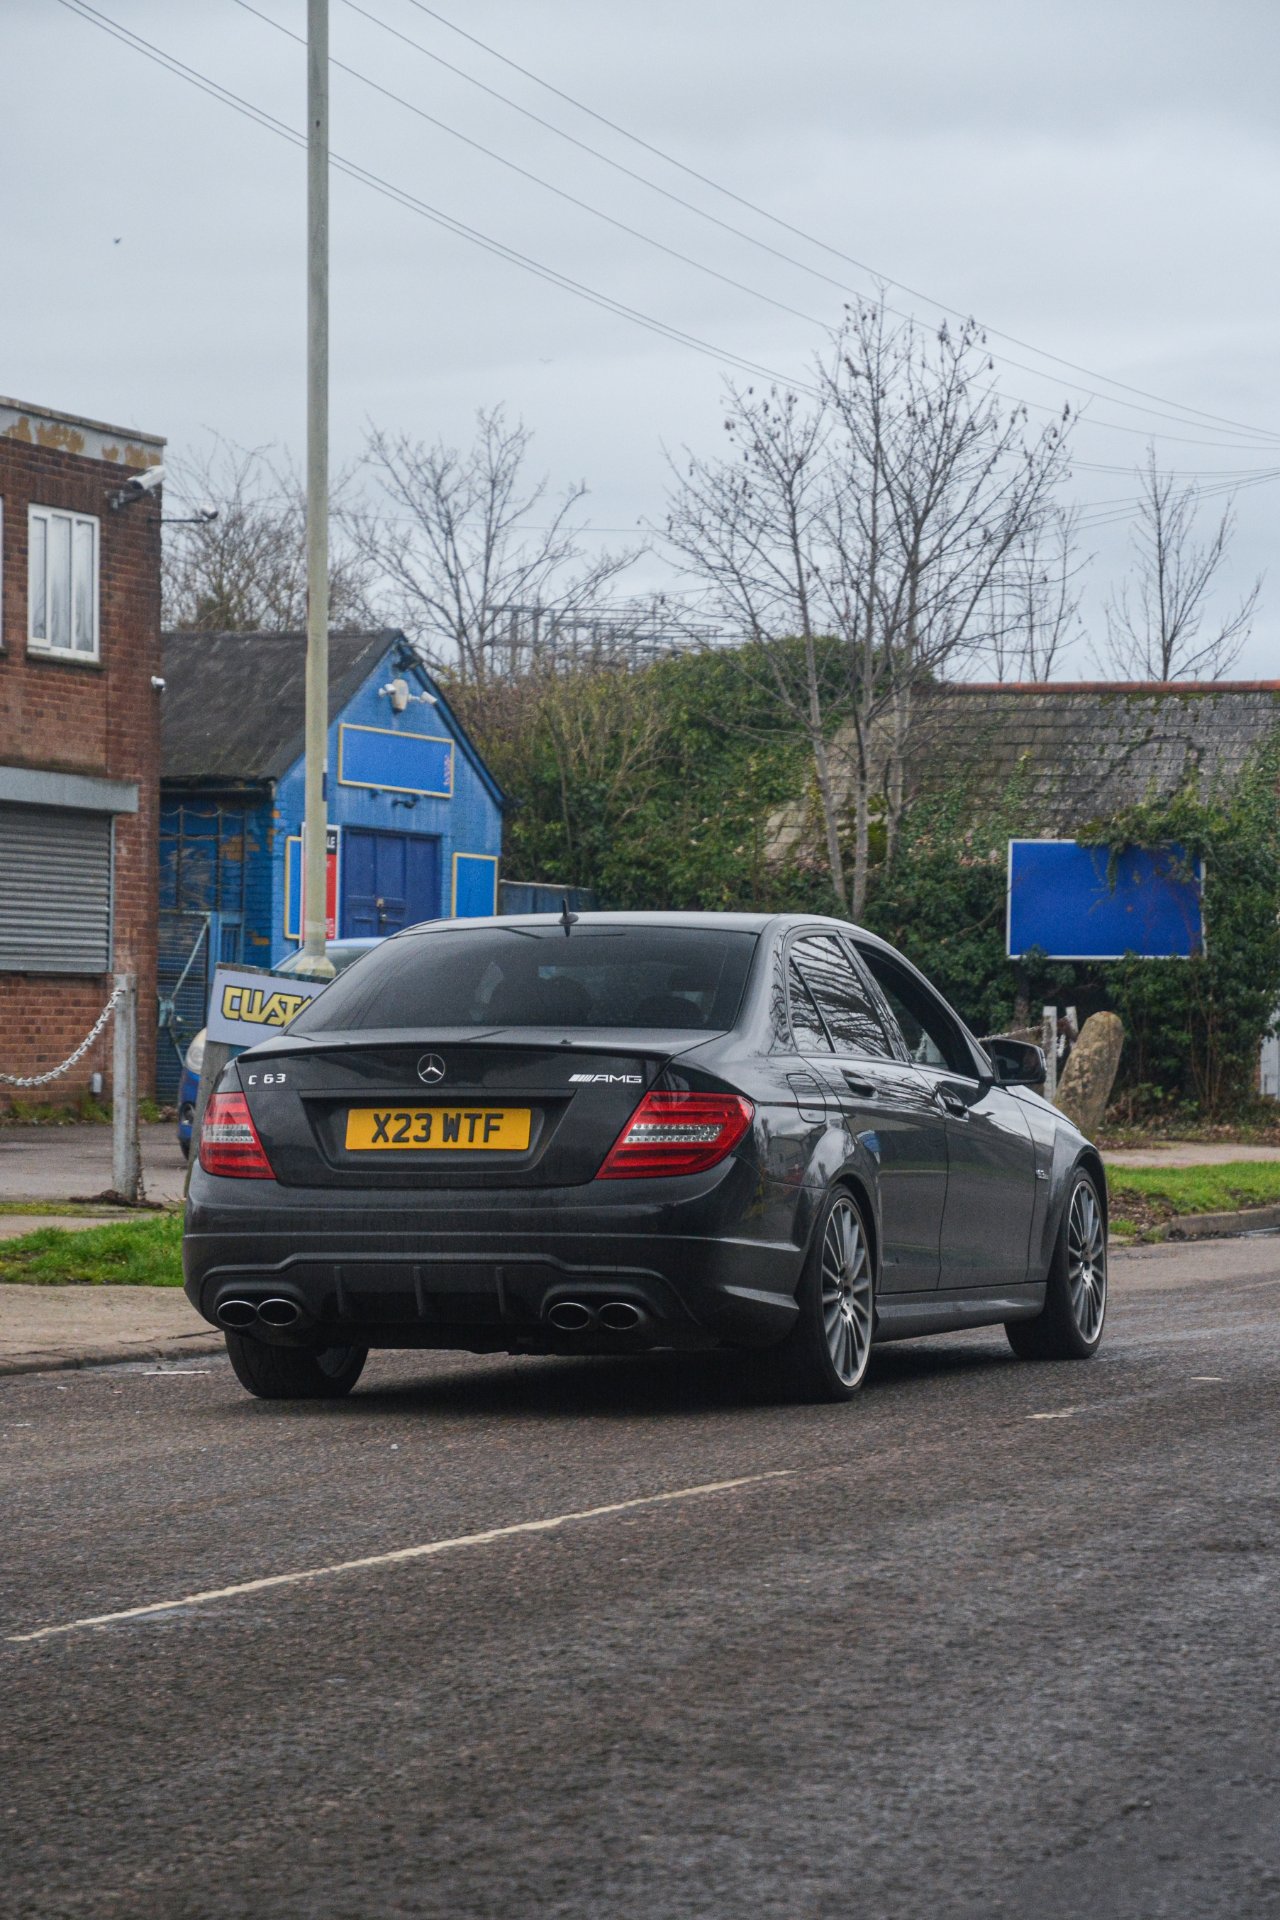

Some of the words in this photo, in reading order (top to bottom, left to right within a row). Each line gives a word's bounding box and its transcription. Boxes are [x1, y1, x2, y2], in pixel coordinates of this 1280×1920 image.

[326, 836, 336, 849] LE
[248, 1075, 258, 1085] C
[263, 1073, 286, 1084] 63
[591, 1074, 642, 1084] AMG
[371, 1113, 433, 1143] X23
[442, 1113, 504, 1143] WTF
